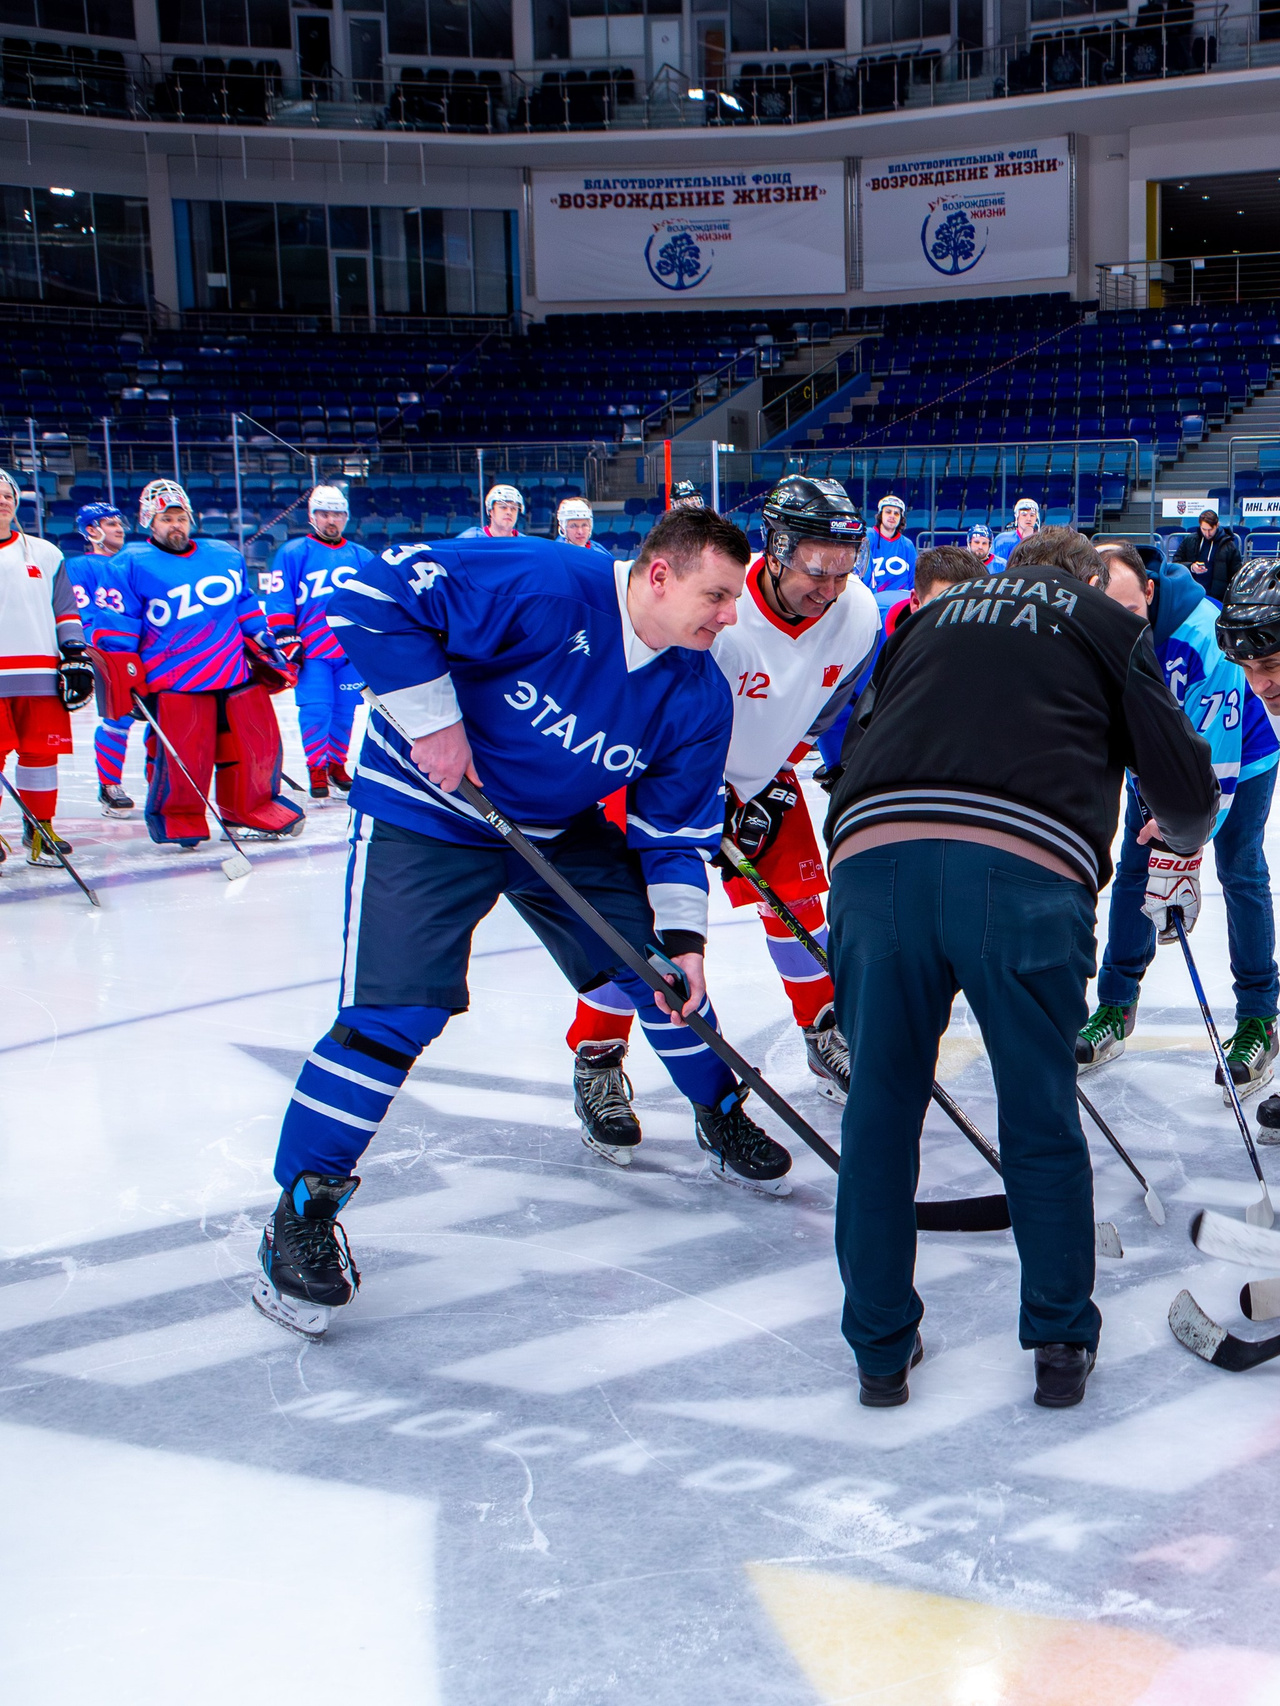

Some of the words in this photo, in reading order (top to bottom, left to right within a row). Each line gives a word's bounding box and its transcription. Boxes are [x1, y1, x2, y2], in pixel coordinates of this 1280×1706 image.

[888, 150, 1005, 174] БЛАГОТВОРИТЕЛЬНЫЙ
[1008, 148, 1038, 161] ФОНД
[583, 172, 747, 190] БЛАГОТВОРИТЕЛЬНЫЙ
[752, 173, 792, 186] ФОНД
[943, 197, 1006, 211] ВОЗРОЖДЕНИЕ
[970, 208, 1007, 220] ЖИЗНИ
[695, 232, 732, 242] ЖИЗНИ
[935, 599, 1038, 634] ЛИГА
[737, 671, 771, 699] 12
[1197, 689, 1241, 733] 73
[771, 904, 810, 949] ALPHA
